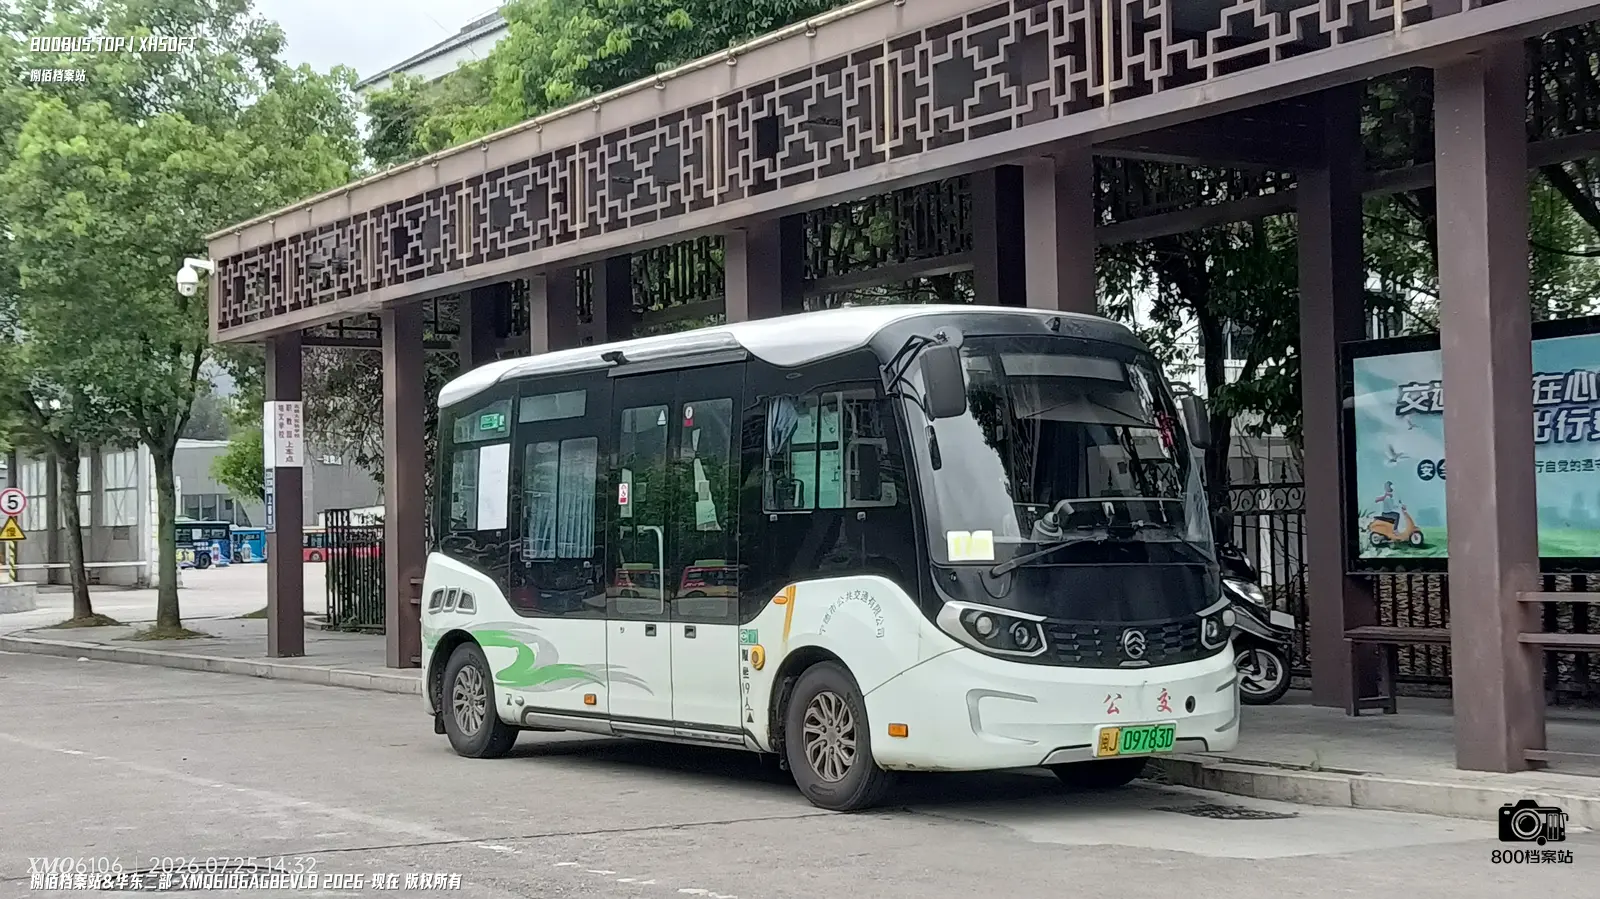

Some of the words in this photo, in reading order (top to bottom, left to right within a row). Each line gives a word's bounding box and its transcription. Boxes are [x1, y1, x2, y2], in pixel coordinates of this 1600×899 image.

[7, 494, 19, 510] 5
[1103, 687, 1172, 714] 公交
[1123, 727, 1174, 751] 09783D
